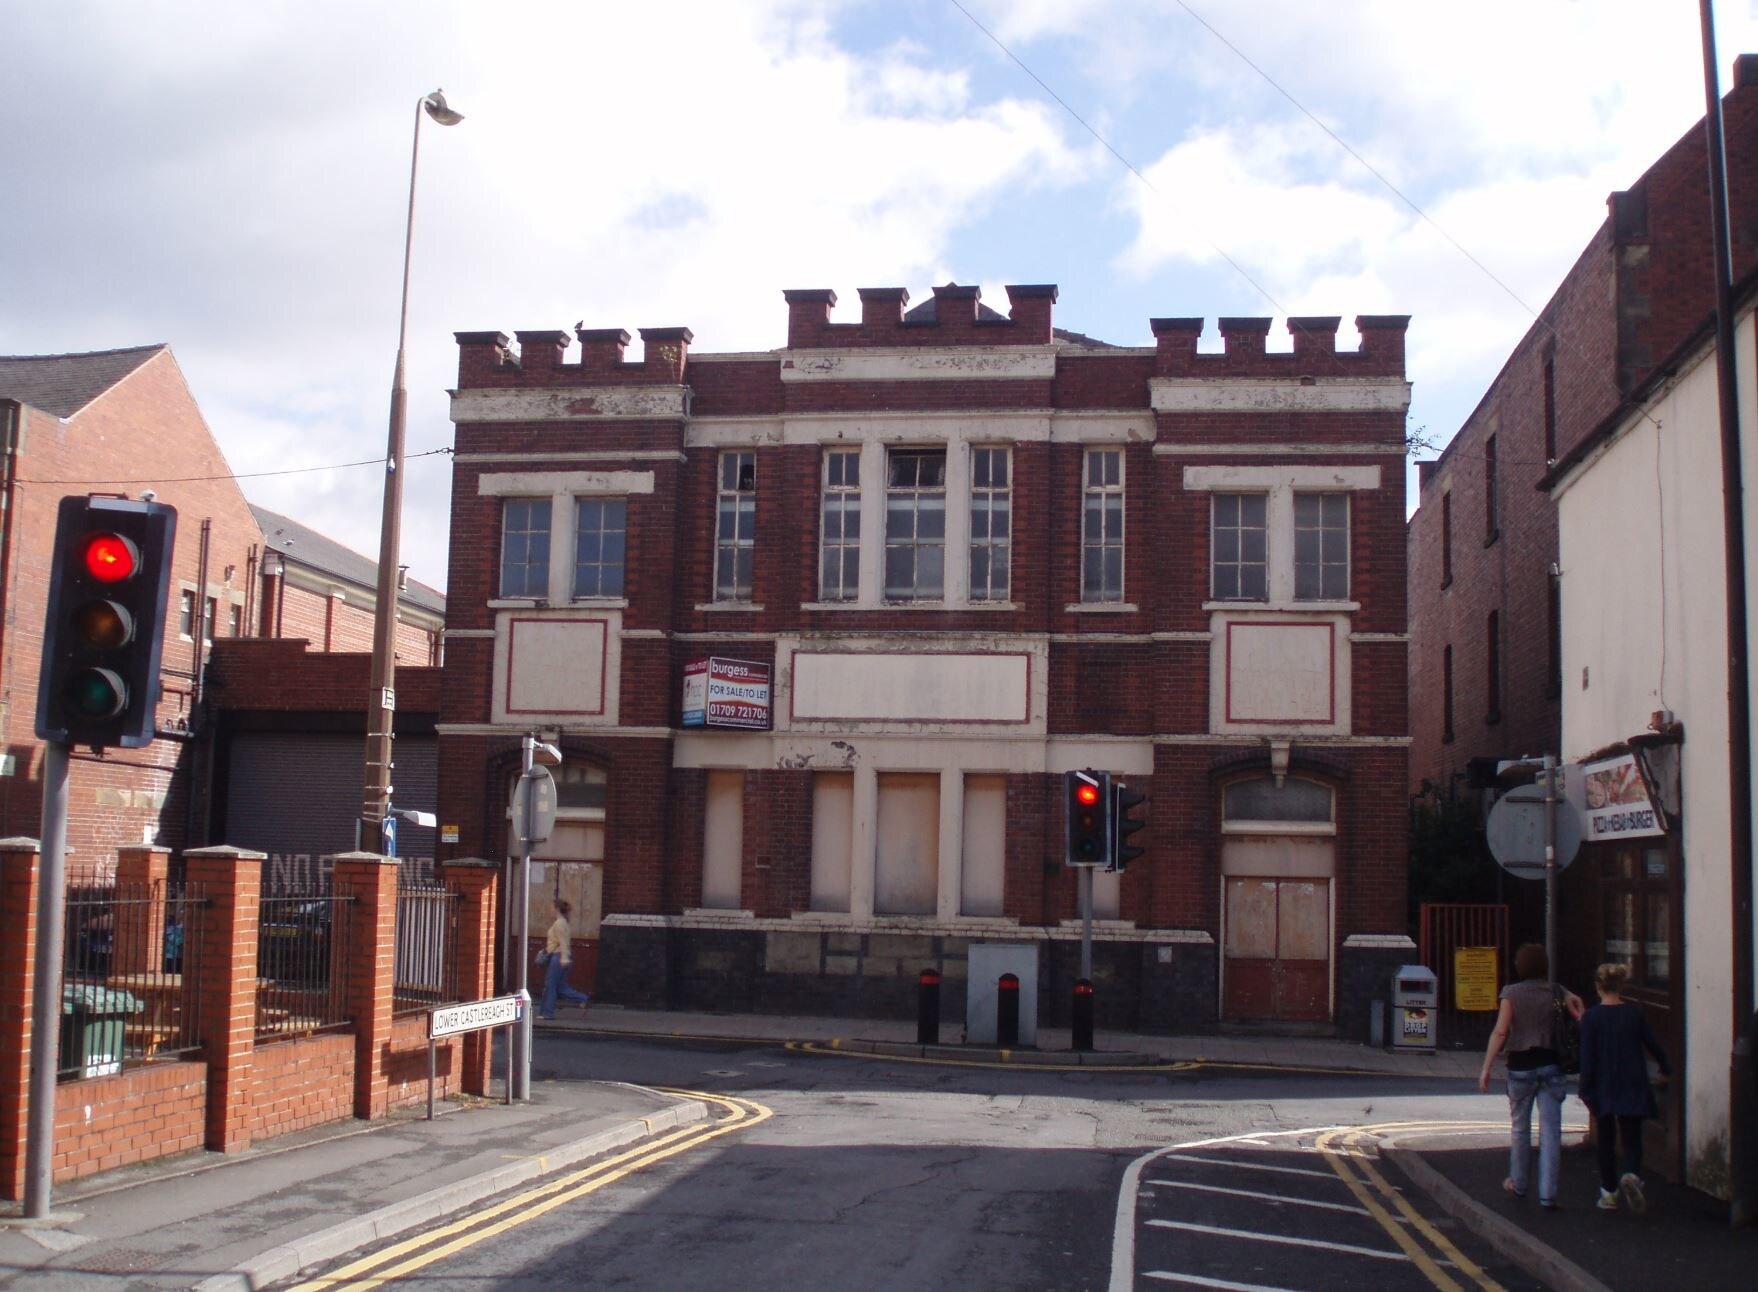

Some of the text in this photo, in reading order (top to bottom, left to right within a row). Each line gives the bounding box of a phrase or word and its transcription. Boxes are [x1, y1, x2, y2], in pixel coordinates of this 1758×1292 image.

[712, 661, 748, 678] burgess
[710, 684, 724, 695] FOR
[757, 689, 767, 699] LET
[710, 704, 736, 717] 01709
[738, 706, 767, 719] 721706
[434, 1002, 514, 1031] LOWER CASTLEREAGH ST
